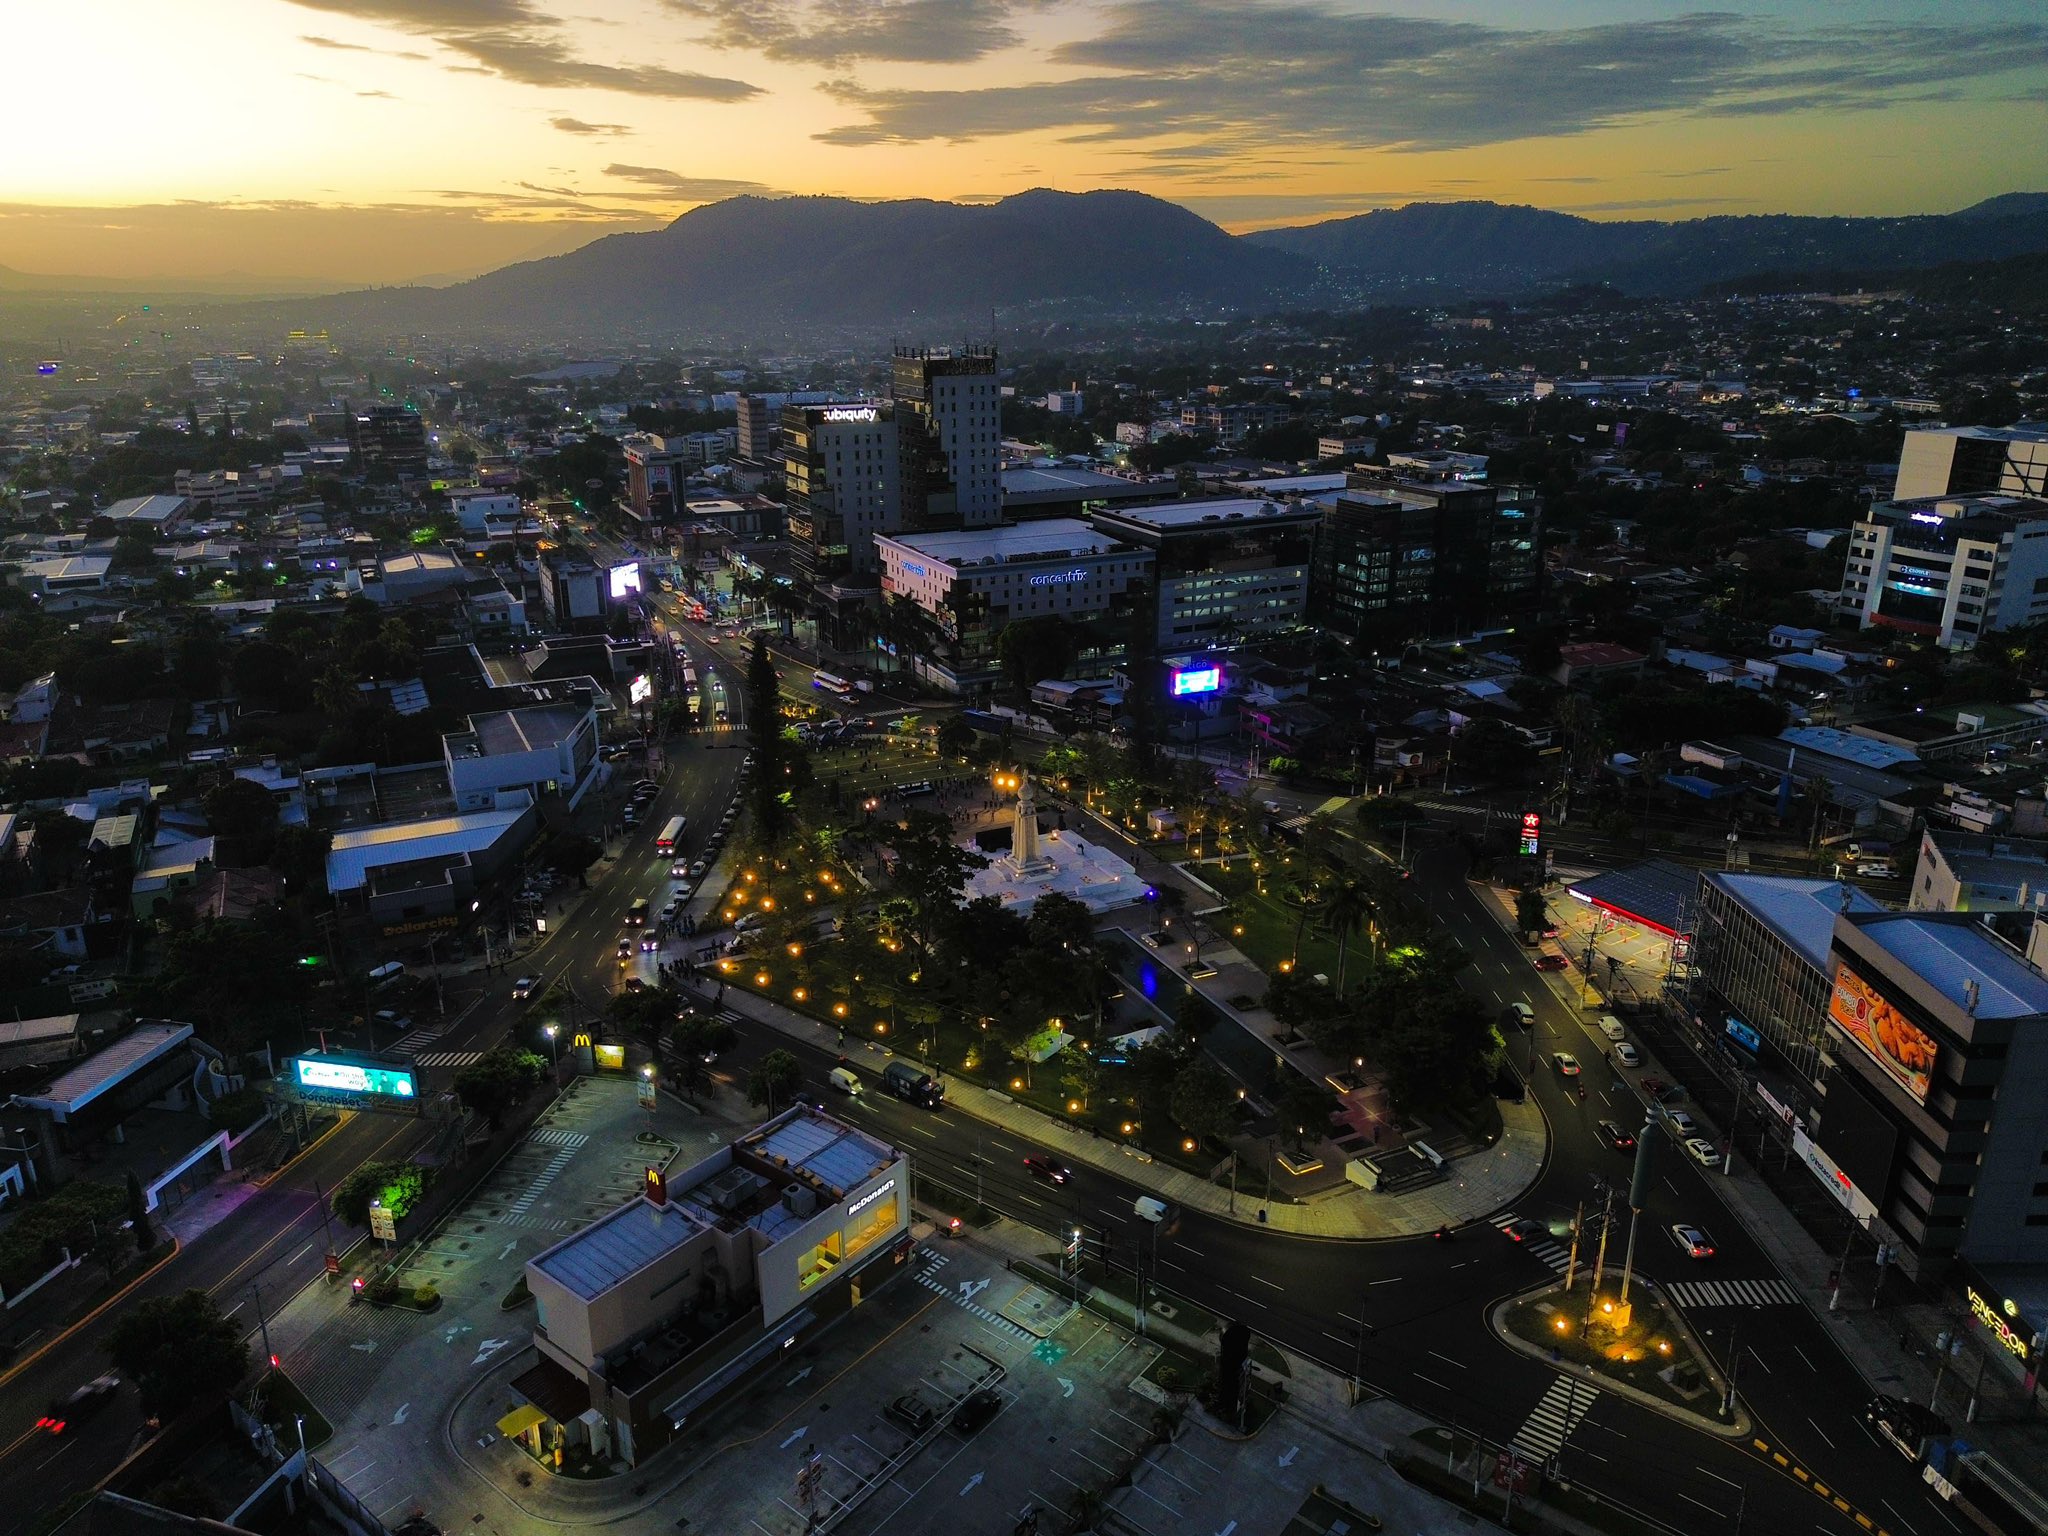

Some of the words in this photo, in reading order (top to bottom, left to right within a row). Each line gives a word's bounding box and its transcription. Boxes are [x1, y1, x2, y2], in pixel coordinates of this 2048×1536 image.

[1030, 569, 1087, 586] concentrix
[383, 916, 458, 937] Dollarcity
[848, 1179, 895, 1216] McDonald's
[1967, 1286, 2027, 1359] VENCEDOR
